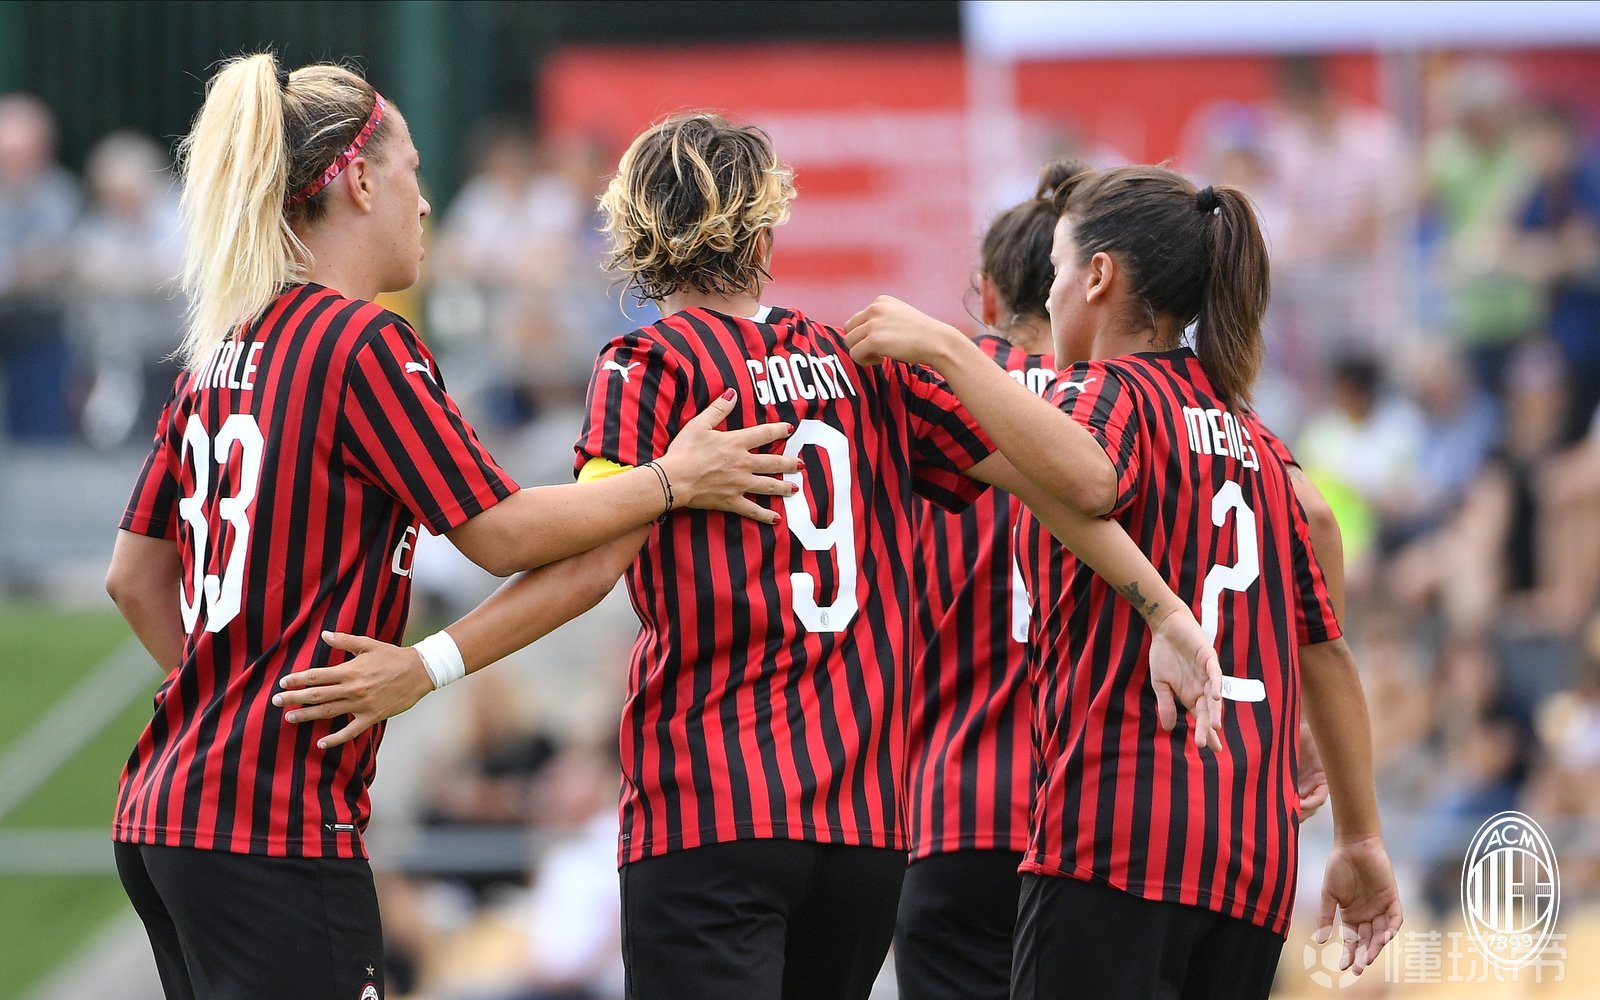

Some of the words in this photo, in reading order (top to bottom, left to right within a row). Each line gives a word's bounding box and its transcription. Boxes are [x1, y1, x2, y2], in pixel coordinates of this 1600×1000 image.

[178, 413, 265, 634] 33
[782, 419, 859, 632] 9
[1201, 479, 1266, 702] 2
